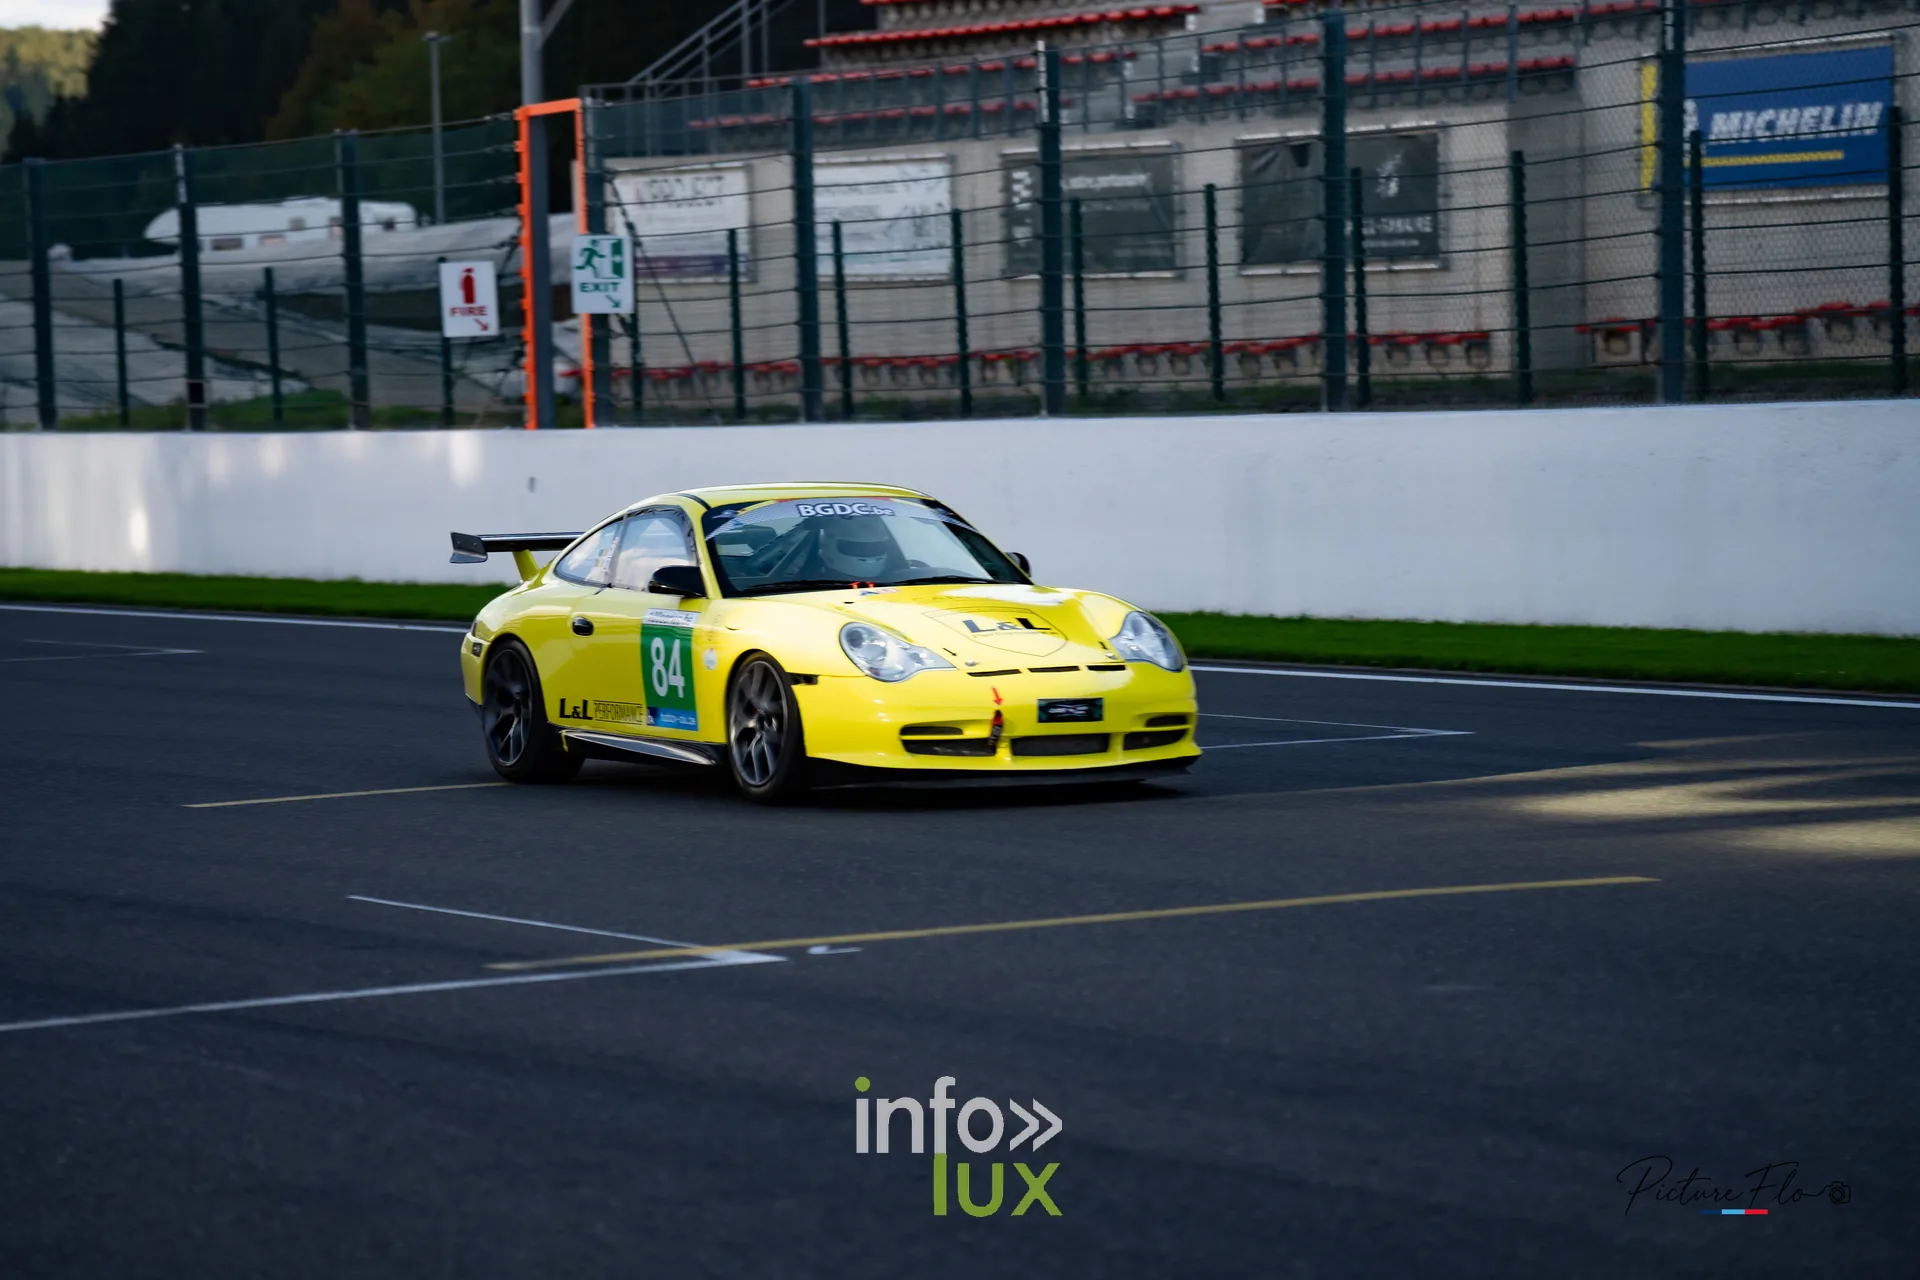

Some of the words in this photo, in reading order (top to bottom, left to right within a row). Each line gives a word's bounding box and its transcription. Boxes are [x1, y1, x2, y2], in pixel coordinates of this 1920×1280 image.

[1708, 102, 1883, 145] MICHELIN
[579, 282, 621, 293] EXIT
[449, 306, 488, 317] FIRE
[797, 503, 895, 517] BGDC.be
[963, 617, 1051, 634] L&L
[651, 637, 685, 698] 84
[559, 698, 593, 720] L&L
